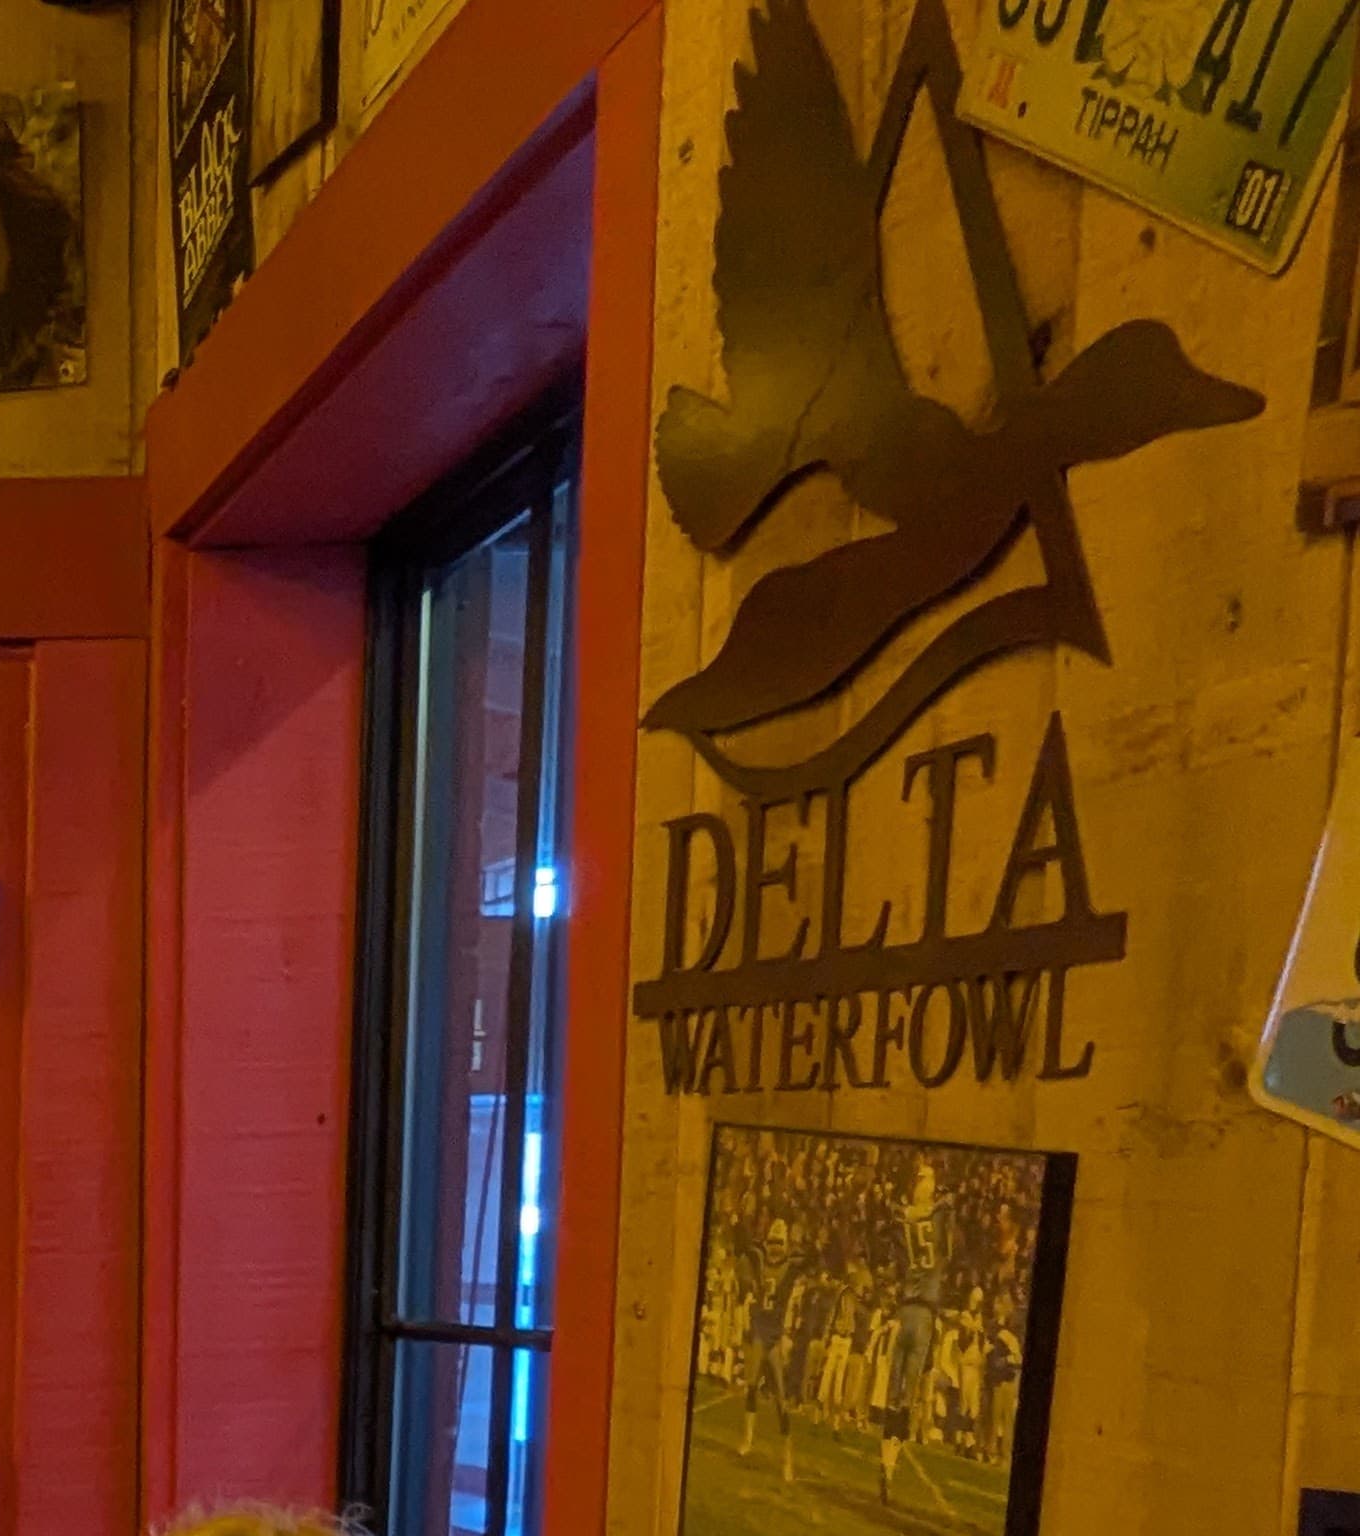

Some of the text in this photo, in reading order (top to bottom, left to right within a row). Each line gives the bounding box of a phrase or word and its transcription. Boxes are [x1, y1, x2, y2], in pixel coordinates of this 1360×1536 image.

[179, 96, 241, 248] BLACK
[1075, 86, 1179, 174] TIPPAH
[662, 710, 1096, 978] DELTA
[658, 966, 1095, 1095] WATERFOWL
